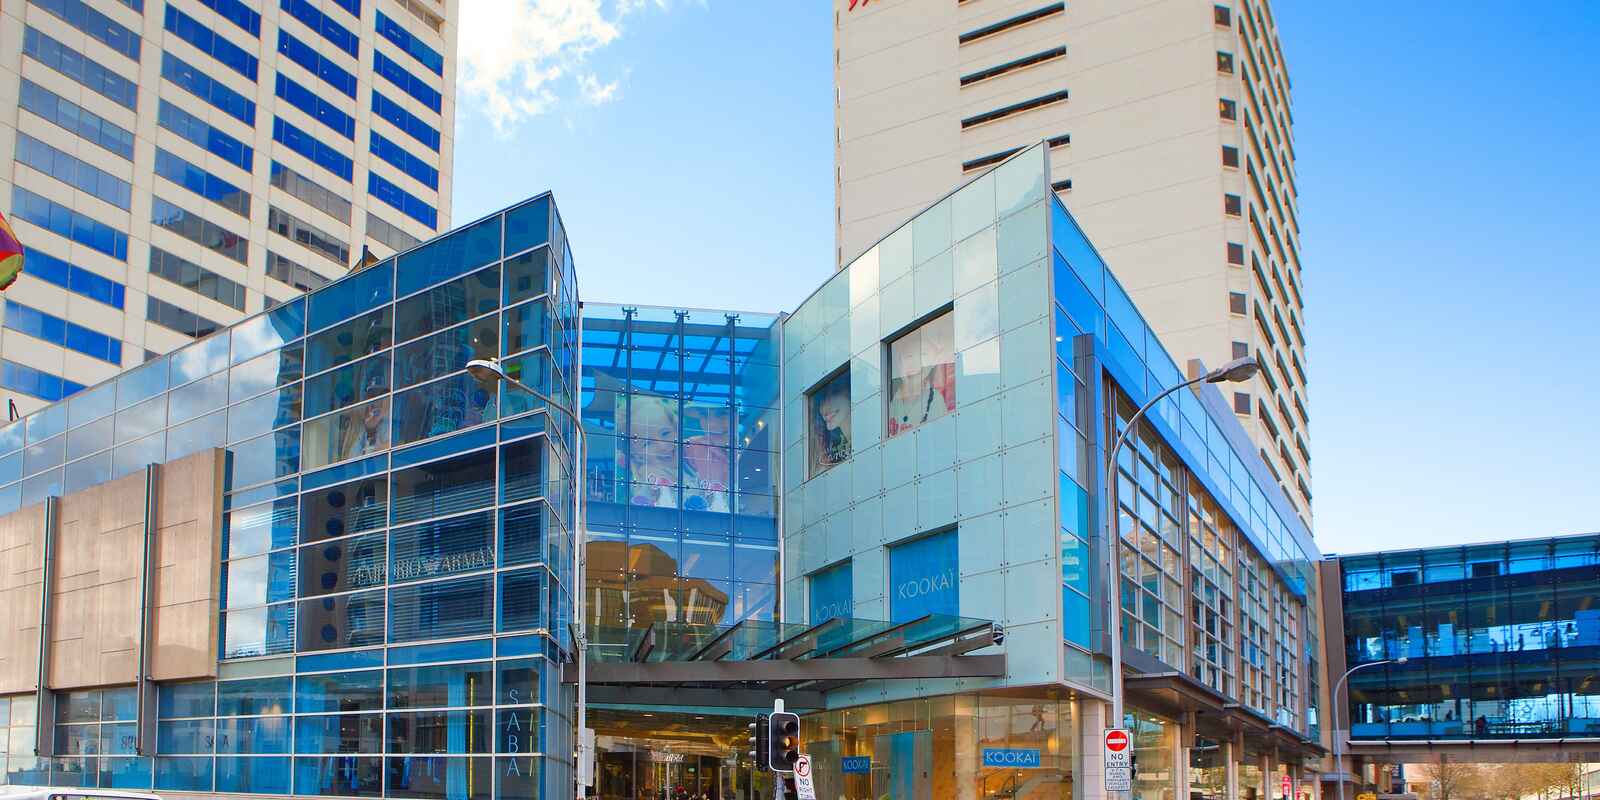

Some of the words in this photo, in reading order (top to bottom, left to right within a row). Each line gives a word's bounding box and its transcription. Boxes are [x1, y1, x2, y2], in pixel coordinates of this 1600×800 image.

[355, 559, 421, 585] EMPRIO
[443, 546, 494, 572] ARMAN
[506, 689, 521, 777] SABA
[799, 778, 809, 786] NO
